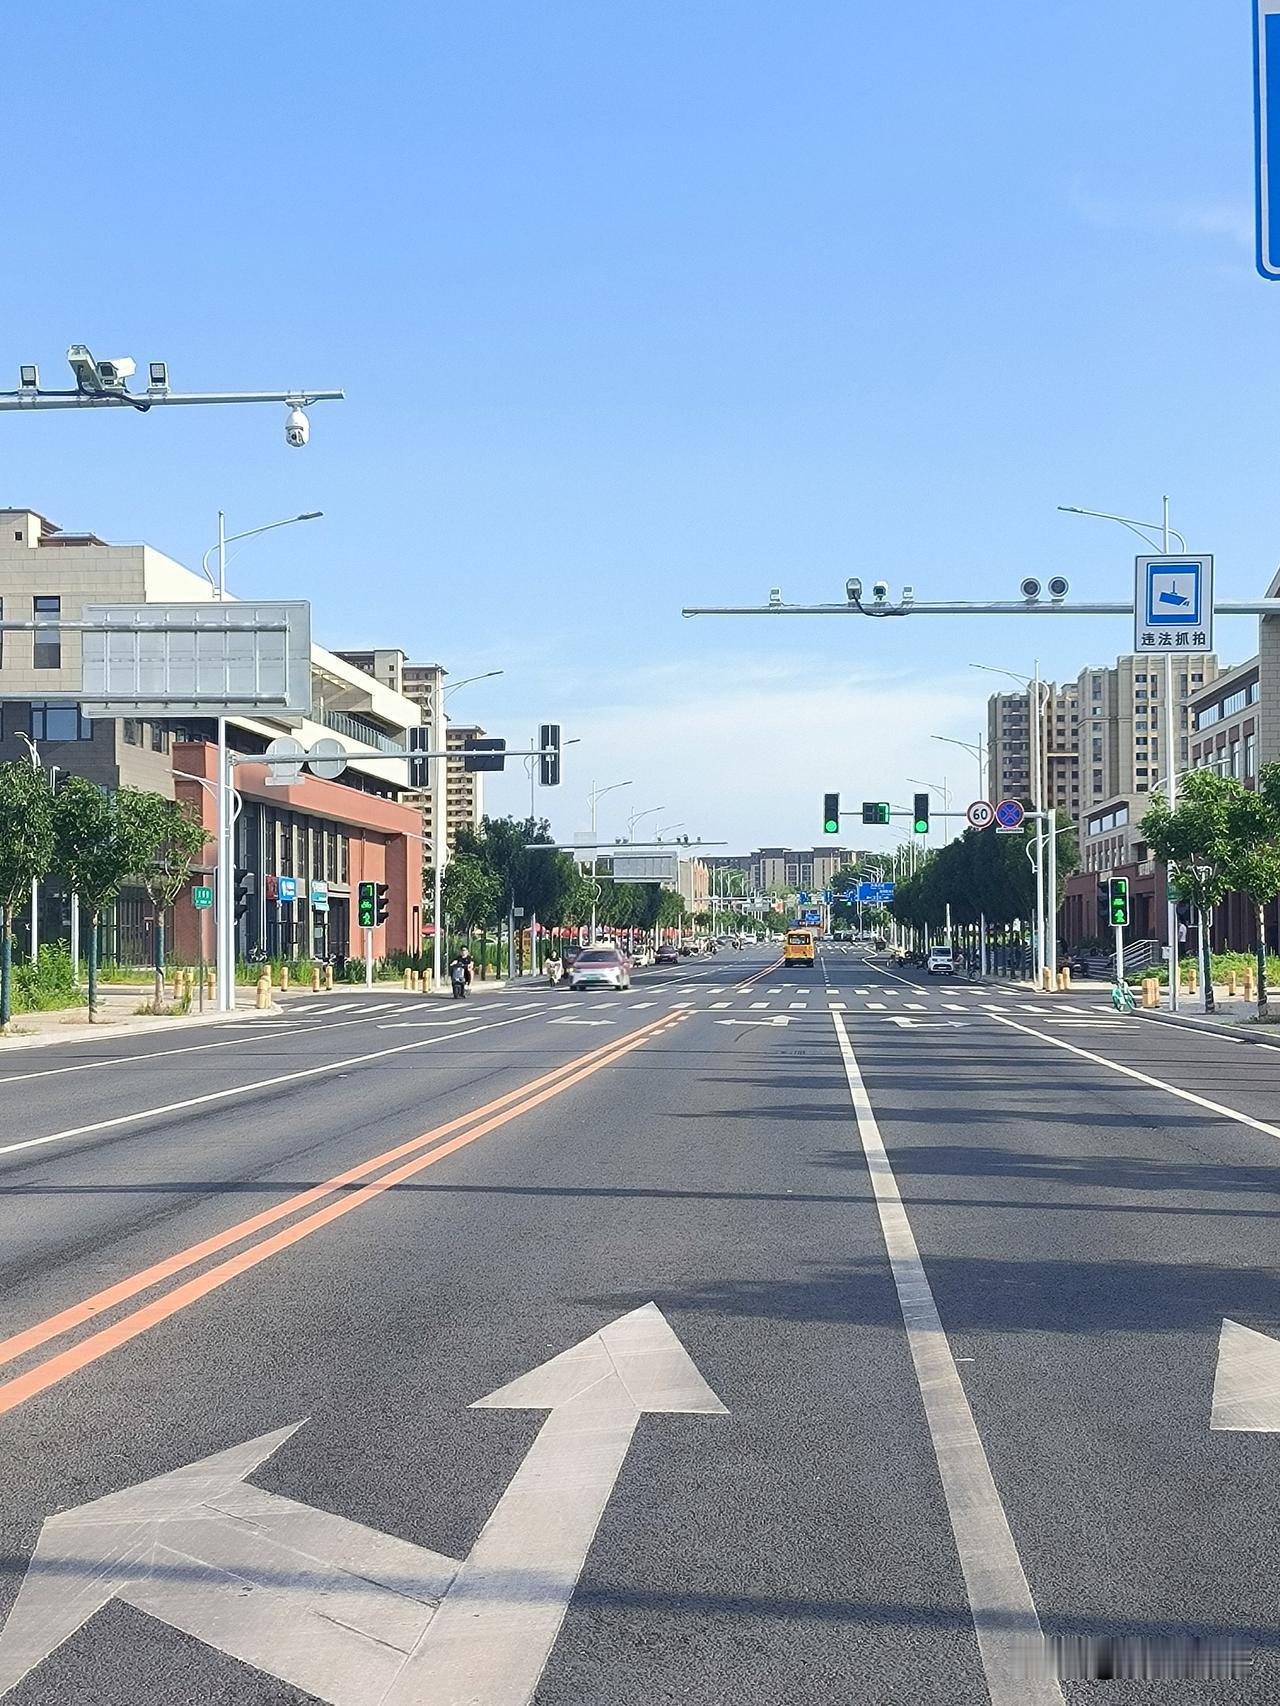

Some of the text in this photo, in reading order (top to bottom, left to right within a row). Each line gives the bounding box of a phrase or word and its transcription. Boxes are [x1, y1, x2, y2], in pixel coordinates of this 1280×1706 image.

[1141, 631, 1206, 646] 违法抓拍
[878, 803, 889, 823] 7
[973, 808, 988, 820] 60
[366, 885, 373, 897] 7
[1117, 881, 1126, 893] 7
